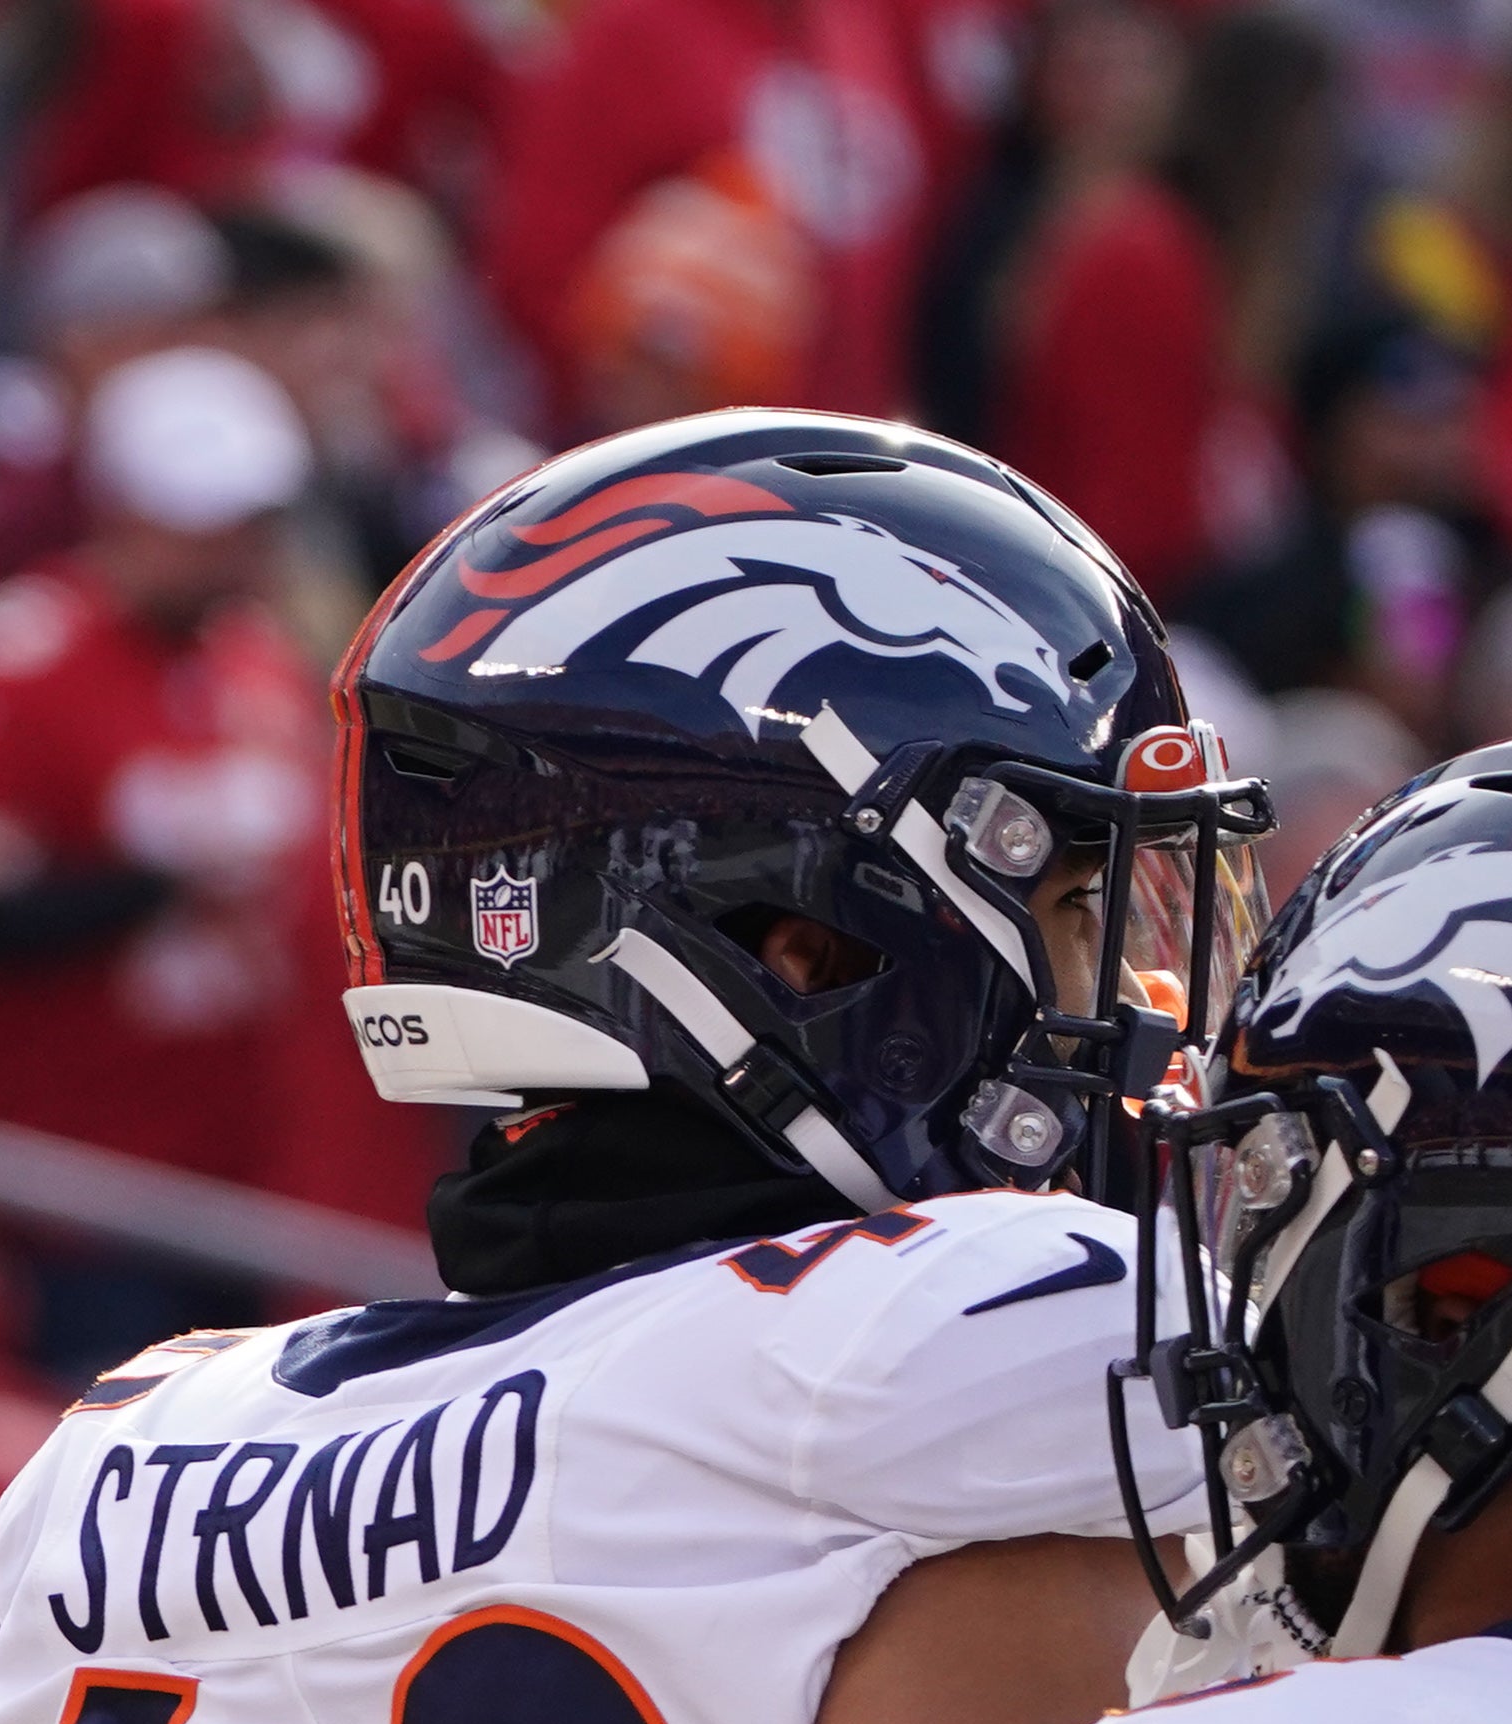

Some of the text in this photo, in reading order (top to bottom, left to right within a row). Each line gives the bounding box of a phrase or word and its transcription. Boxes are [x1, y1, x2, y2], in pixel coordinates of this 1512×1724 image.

[378, 861, 431, 925] 40
[481, 913, 529, 952] NFL
[48, 1368, 547, 1654] STRNAD
